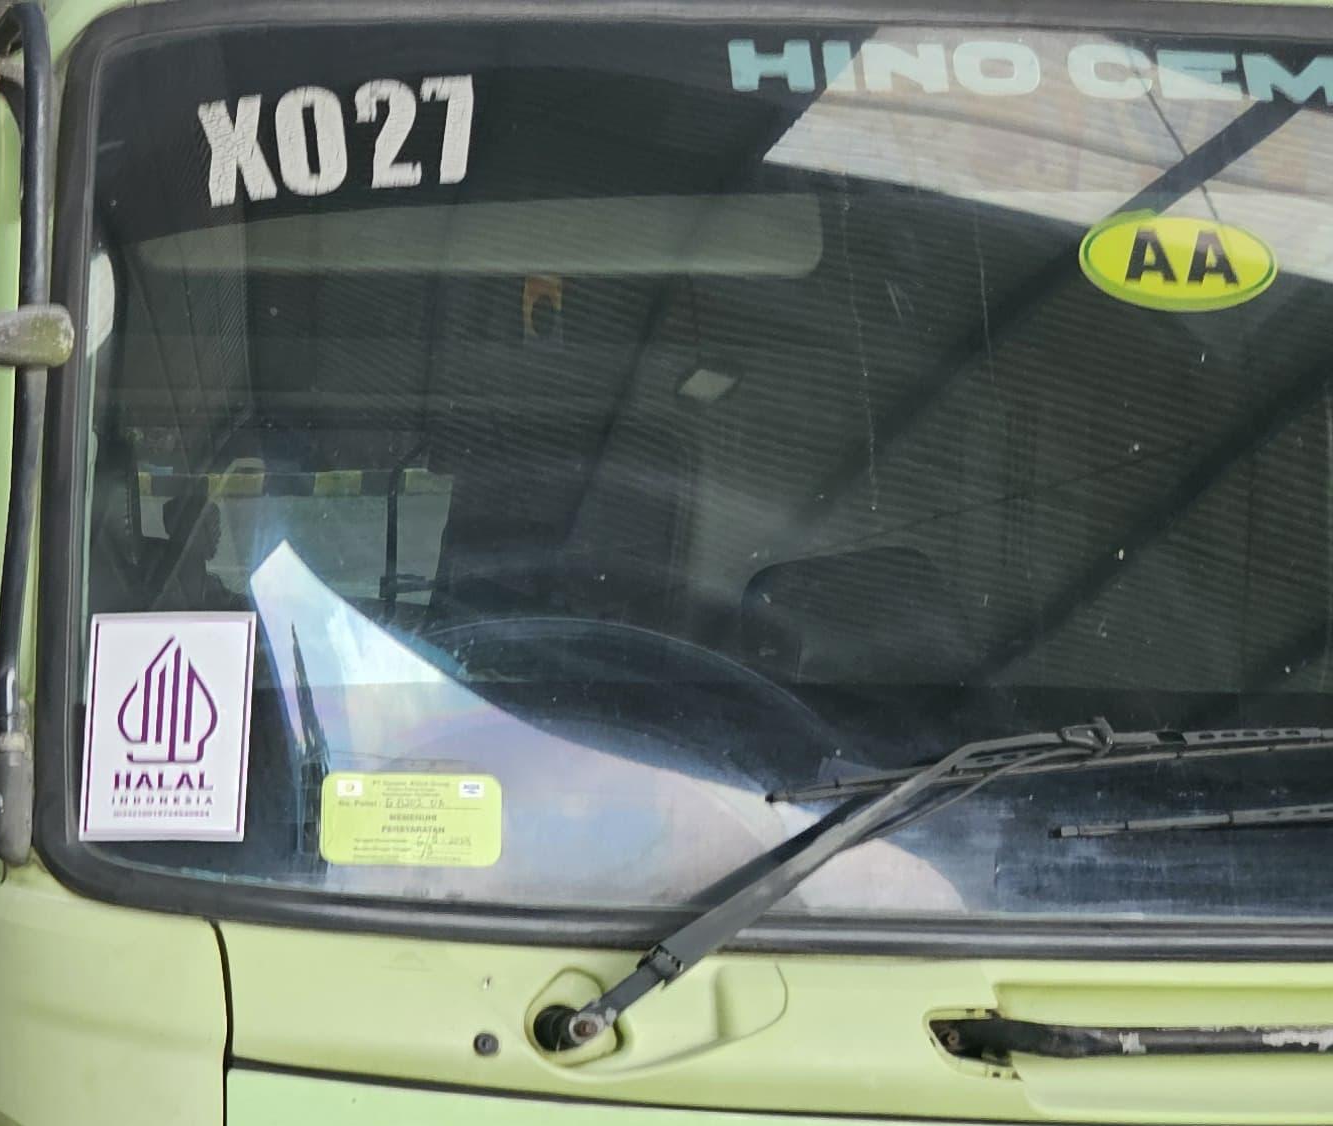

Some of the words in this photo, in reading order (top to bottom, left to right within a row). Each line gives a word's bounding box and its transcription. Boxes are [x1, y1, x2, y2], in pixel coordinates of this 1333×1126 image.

[728, 39, 1041, 96] HINO
[1124, 228, 1241, 287] AA
[112, 794, 213, 806] INDONESIA
[114, 770, 214, 791] HALAL
